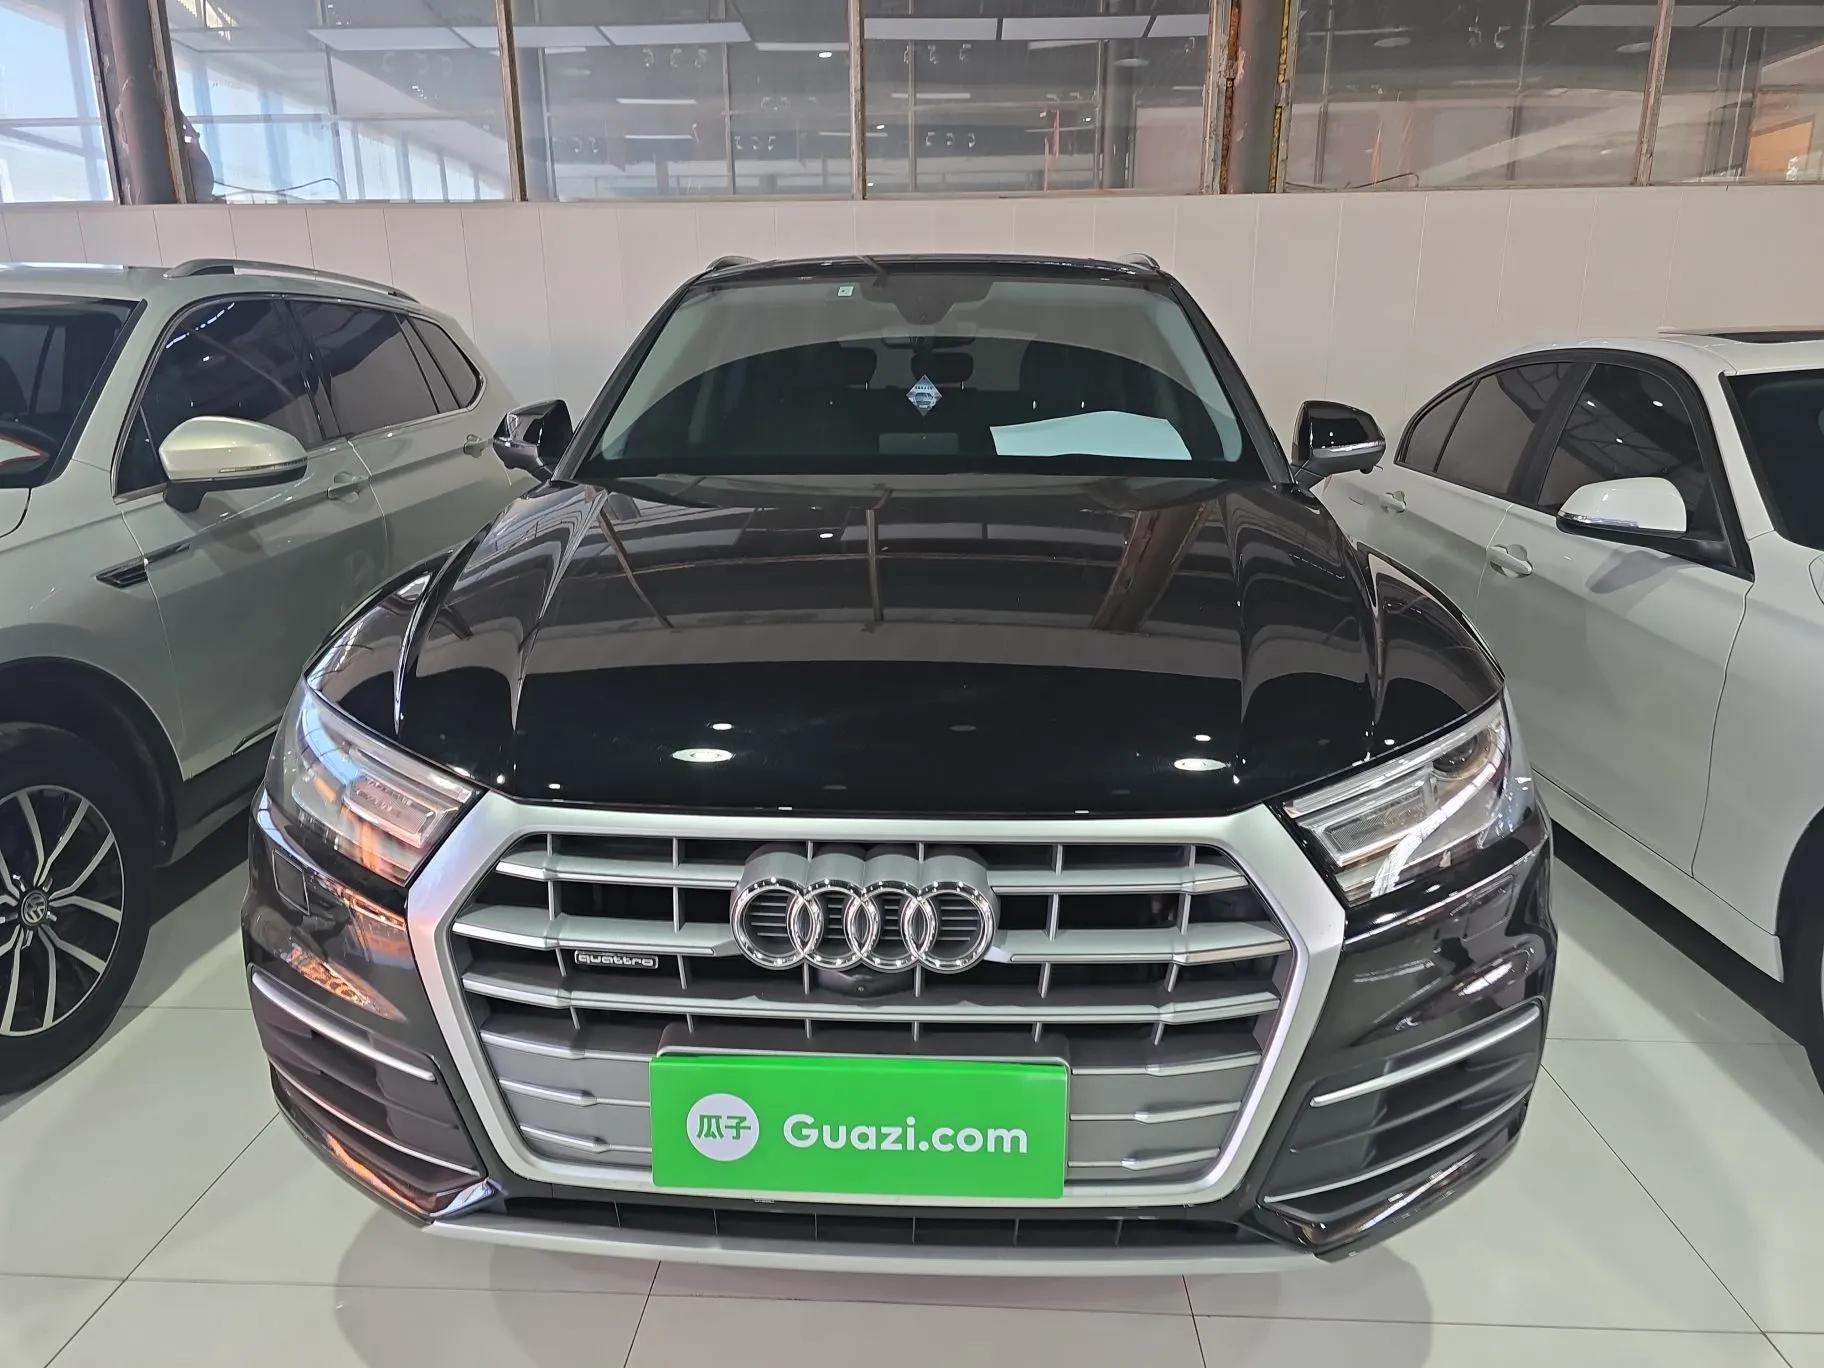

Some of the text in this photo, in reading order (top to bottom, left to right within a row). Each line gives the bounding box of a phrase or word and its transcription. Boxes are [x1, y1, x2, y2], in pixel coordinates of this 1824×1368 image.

[578, 954, 654, 966] quattro
[696, 1113, 1028, 1153] 瓜子 Guazi.com
